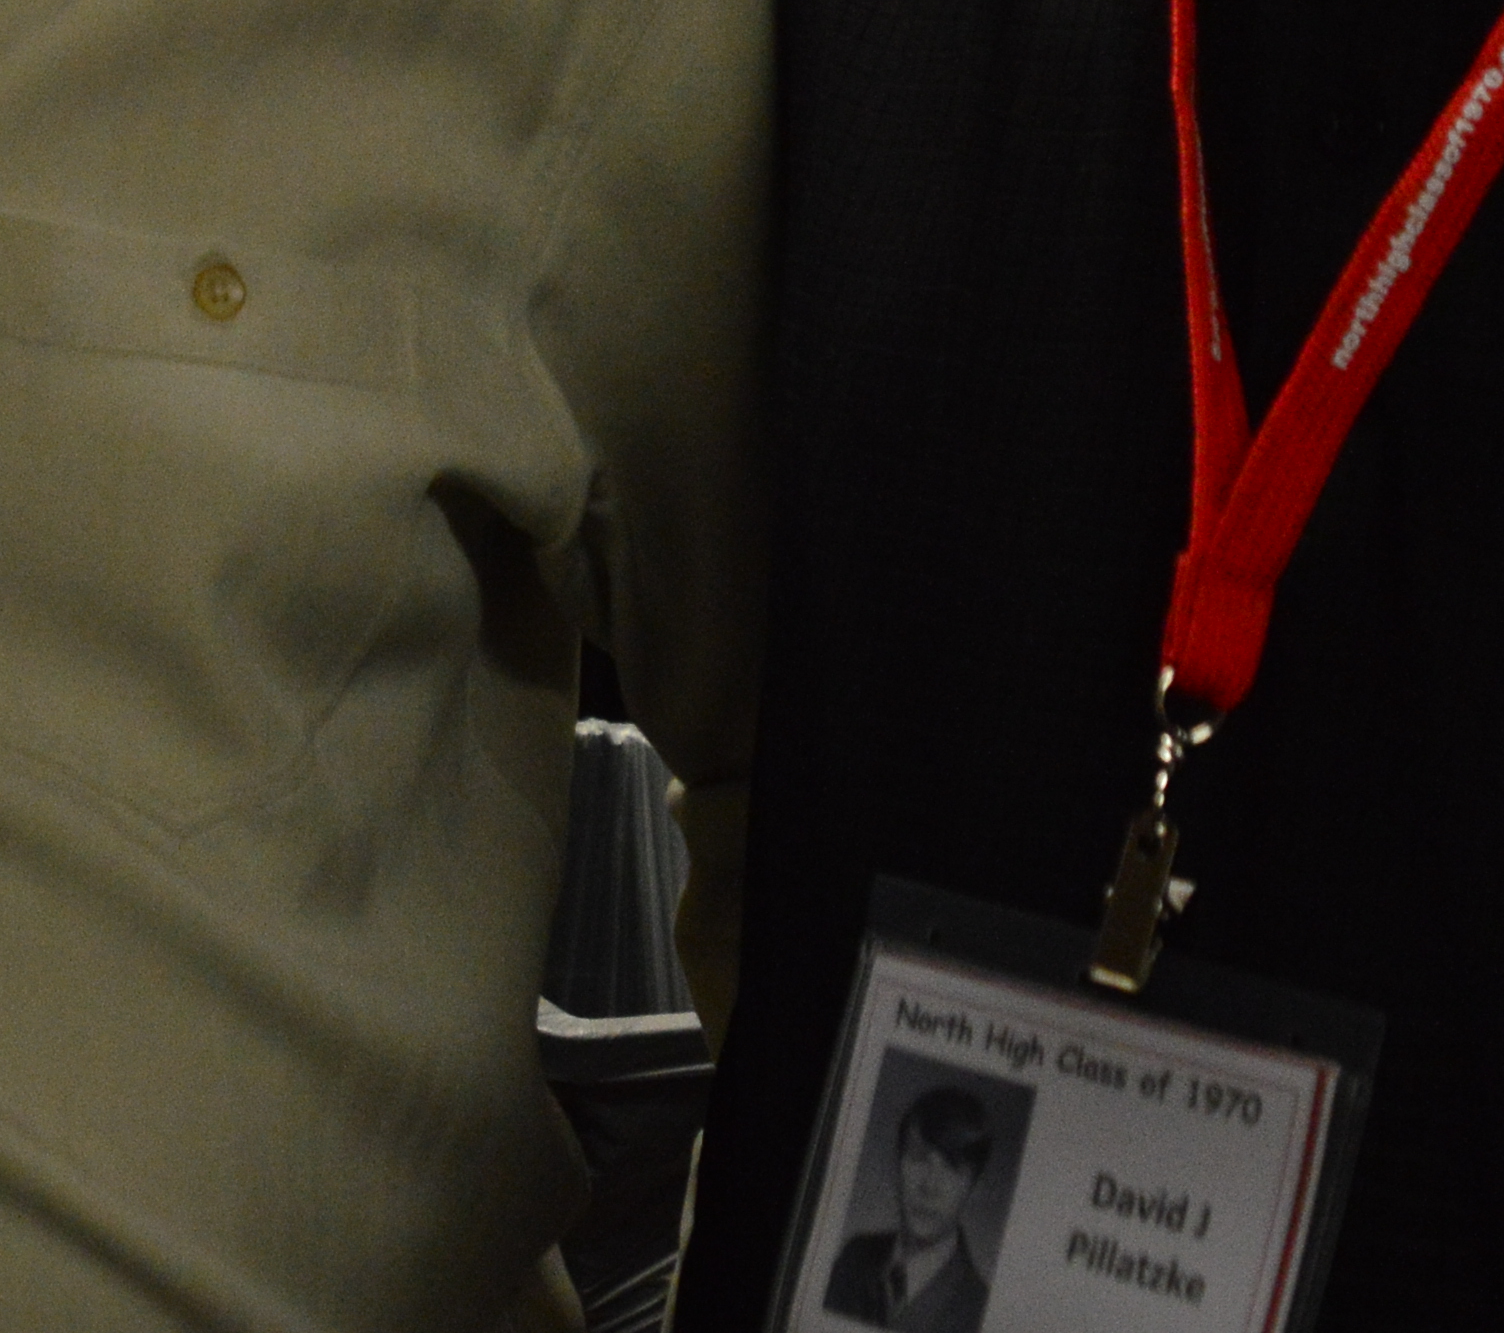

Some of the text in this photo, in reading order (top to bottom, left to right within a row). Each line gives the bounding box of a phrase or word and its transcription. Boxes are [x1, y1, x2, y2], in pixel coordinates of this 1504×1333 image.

[893, 996, 1262, 1128] North High Class of 1970
[1089, 1170, 1212, 1240] David J
[1065, 1230, 1207, 1305] Pillatzke
